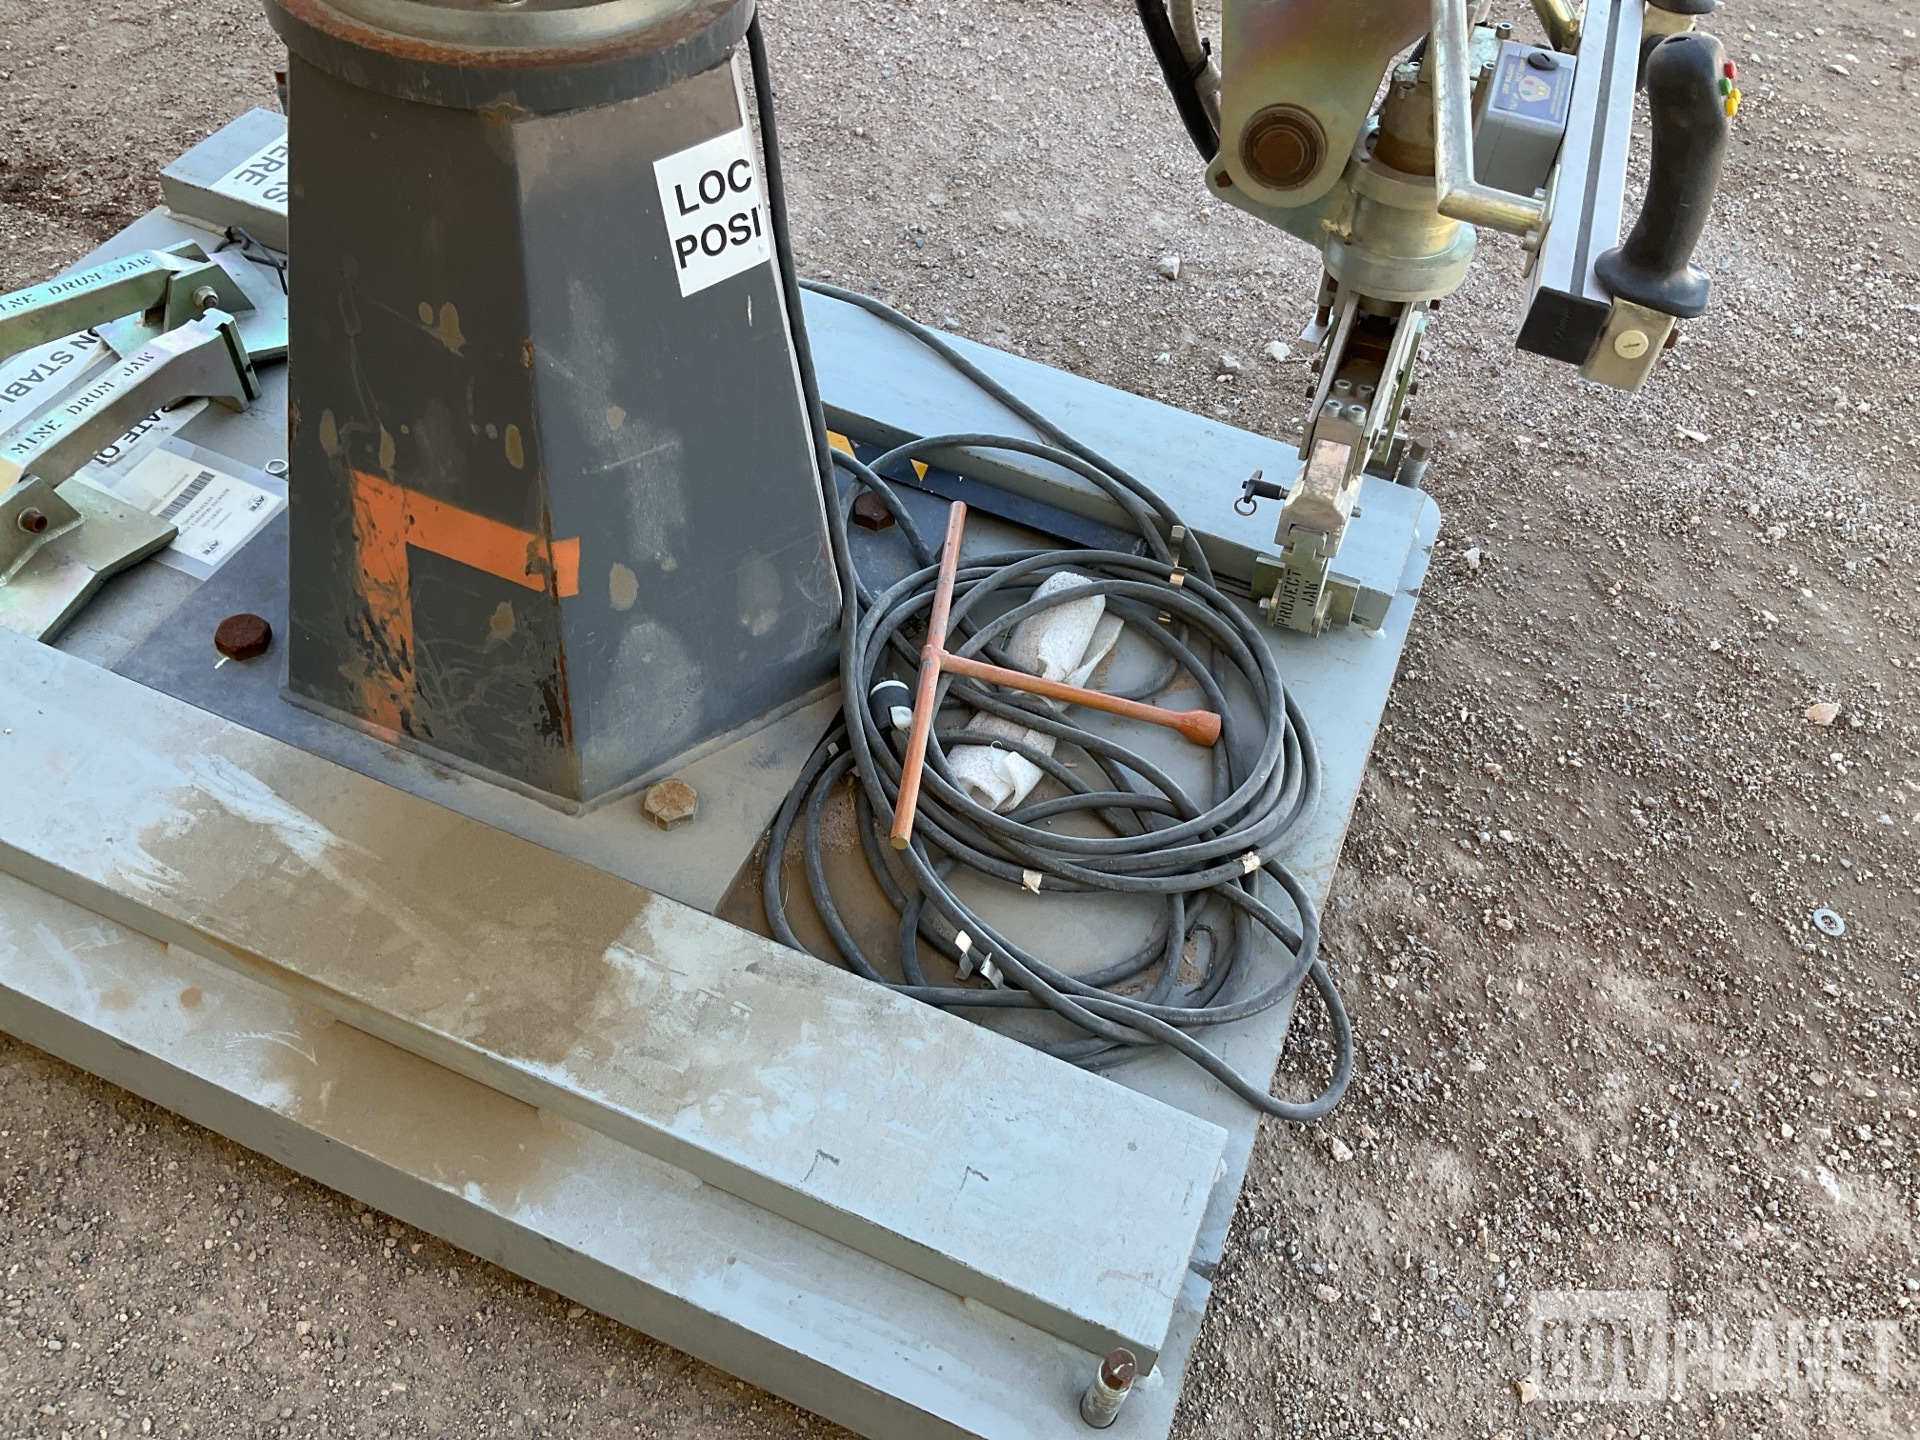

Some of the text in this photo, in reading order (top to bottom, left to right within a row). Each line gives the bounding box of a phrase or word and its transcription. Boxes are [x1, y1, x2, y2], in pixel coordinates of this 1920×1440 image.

[233, 141, 288, 186] ERE
[674, 158, 752, 217] LOC
[674, 203, 762, 270] POSI
[48, 272, 102, 295] DRUM
[11, 420, 63, 454] MINE
[66, 381, 115, 415] DRUM
[123, 405, 172, 444] ATE
[1275, 568, 1301, 627] PROJECT
